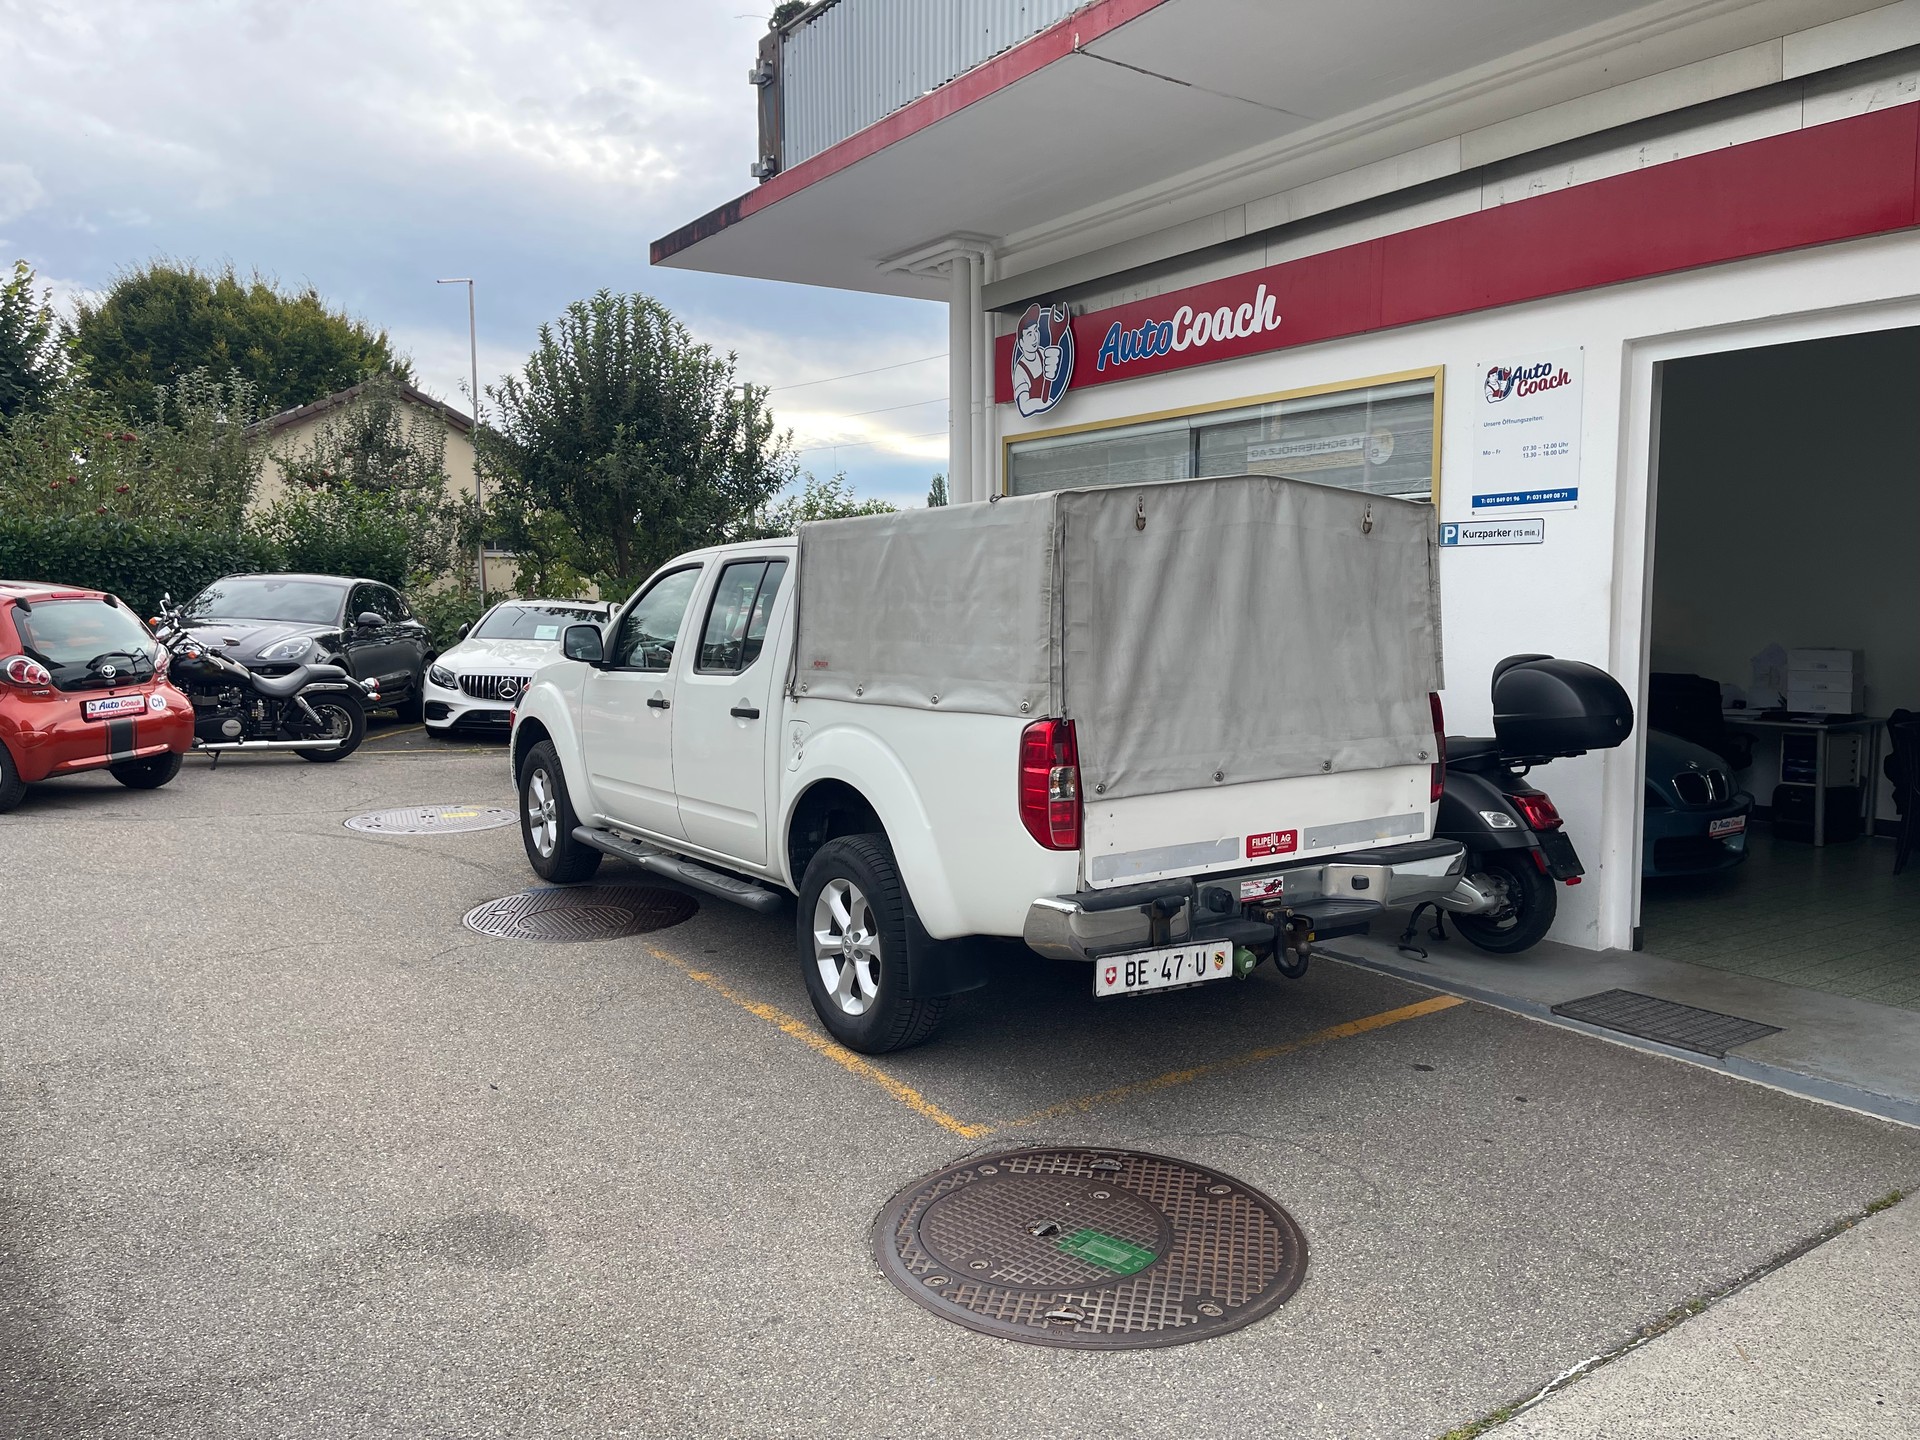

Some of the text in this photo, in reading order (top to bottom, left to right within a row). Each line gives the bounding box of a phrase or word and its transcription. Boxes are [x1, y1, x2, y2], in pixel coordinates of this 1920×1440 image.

[1510, 362, 1552, 387] Auto
[1517, 368, 1571, 397] Coach
[1483, 415, 1545, 428] Unsere Öffnungszeiten:
[1444, 526, 1540, 544] P Kurzparker (15 min.)
[99, 700, 120, 711] Auto
[151, 698, 164, 708] CH
[1280, 833, 1291, 843] AG
